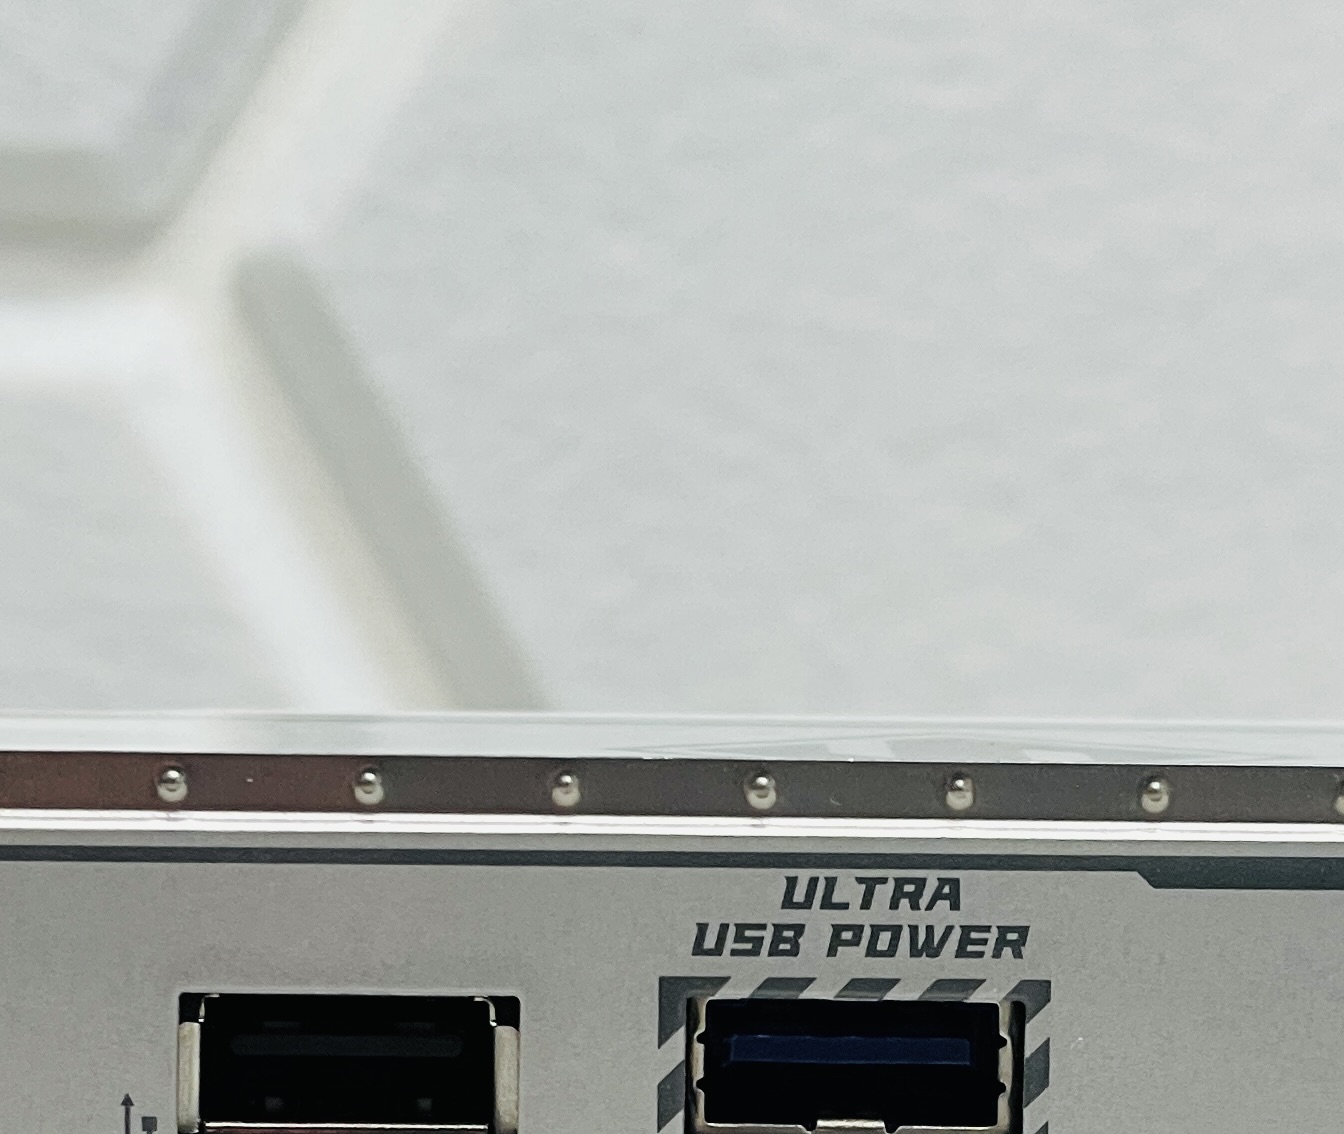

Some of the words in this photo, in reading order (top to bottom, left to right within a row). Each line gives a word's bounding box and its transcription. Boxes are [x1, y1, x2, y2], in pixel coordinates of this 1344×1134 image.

[780, 875, 962, 912] ULTRA
[691, 922, 805, 958] USB
[826, 923, 1031, 960] POWER
